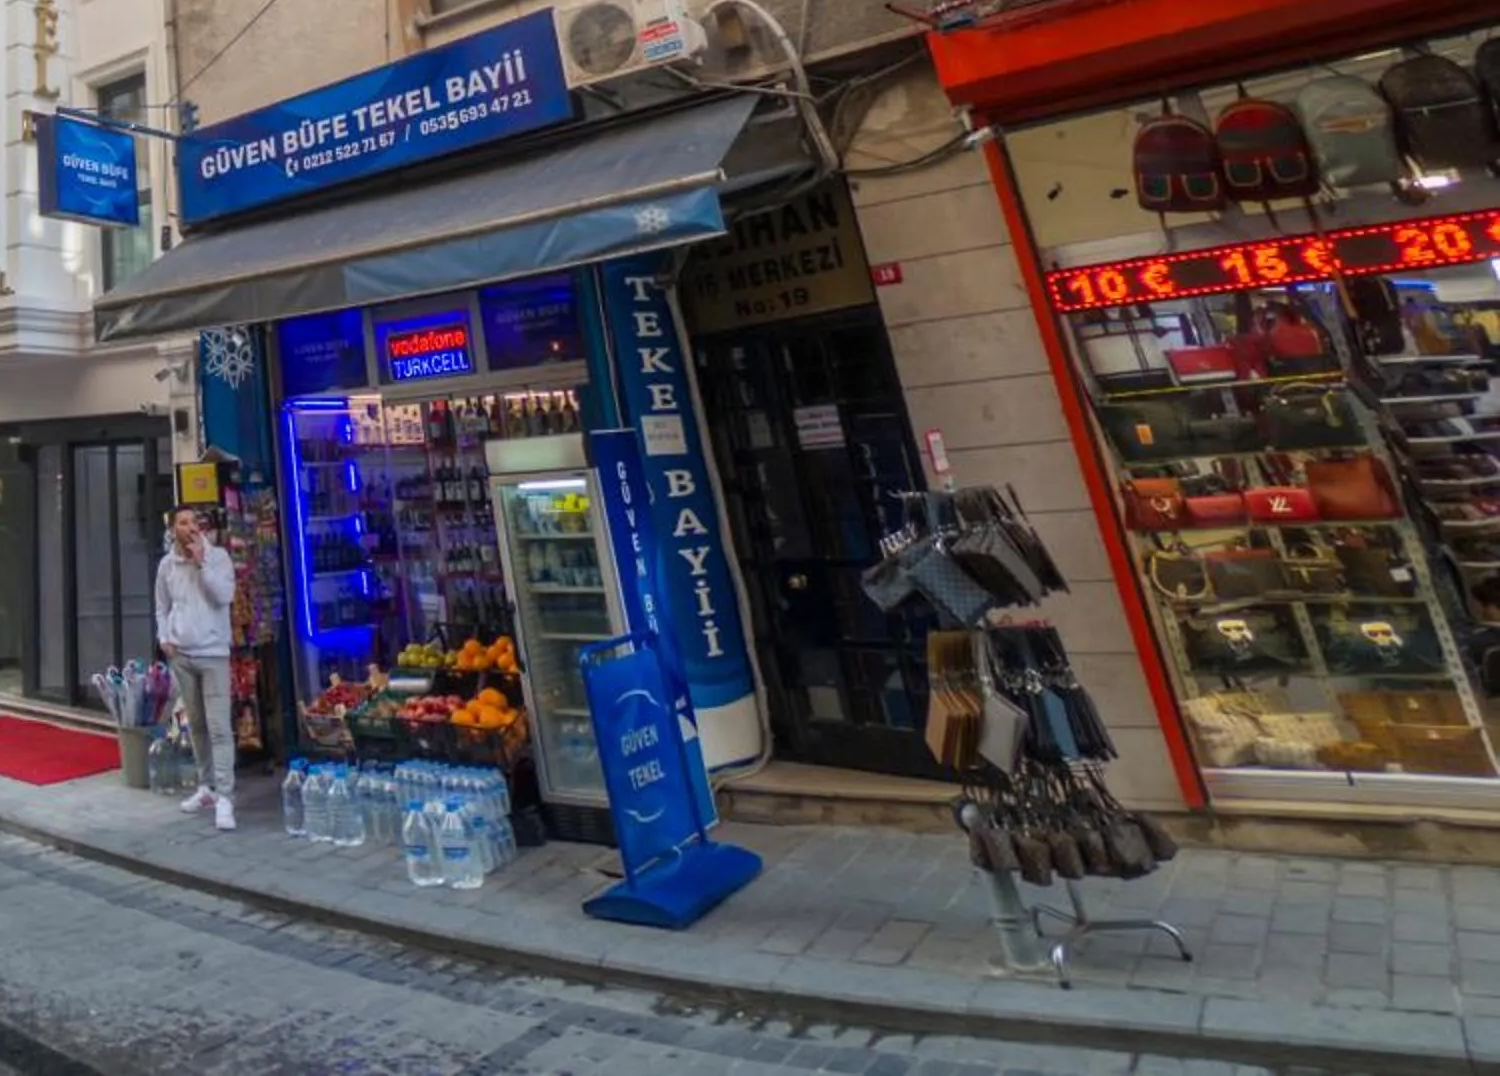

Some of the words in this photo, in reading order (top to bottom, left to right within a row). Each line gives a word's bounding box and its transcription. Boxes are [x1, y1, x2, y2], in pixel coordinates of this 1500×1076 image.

[201, 136, 277, 180] GÜVEN
[282, 114, 349, 155] BÜFE
[352, 85, 441, 132] TEKEL
[445, 48, 528, 103] BAYİİ
[303, 149, 333, 170] 0212
[335, 141, 361, 161] 522
[361, 136, 378, 153] 71
[420, 110, 459, 136] 0535
[491, 95, 509, 114] 47
[512, 89, 532, 108] 21
[63, 153, 99, 173] GÜVEN
[1068, 272, 1128, 305] 10
[1222, 246, 1288, 283] 15
[1393, 223, 1473, 263] 20
[391, 330, 465, 356] vodafone
[394, 353, 469, 379] TURKCELL
[625, 276, 679, 412] TEKE
[663, 469, 724, 658] BAYİİ
[616, 461, 647, 577] GÜVEN
[620, 723, 659, 756] GÜVEN
[627, 758, 666, 791] TEKEL
